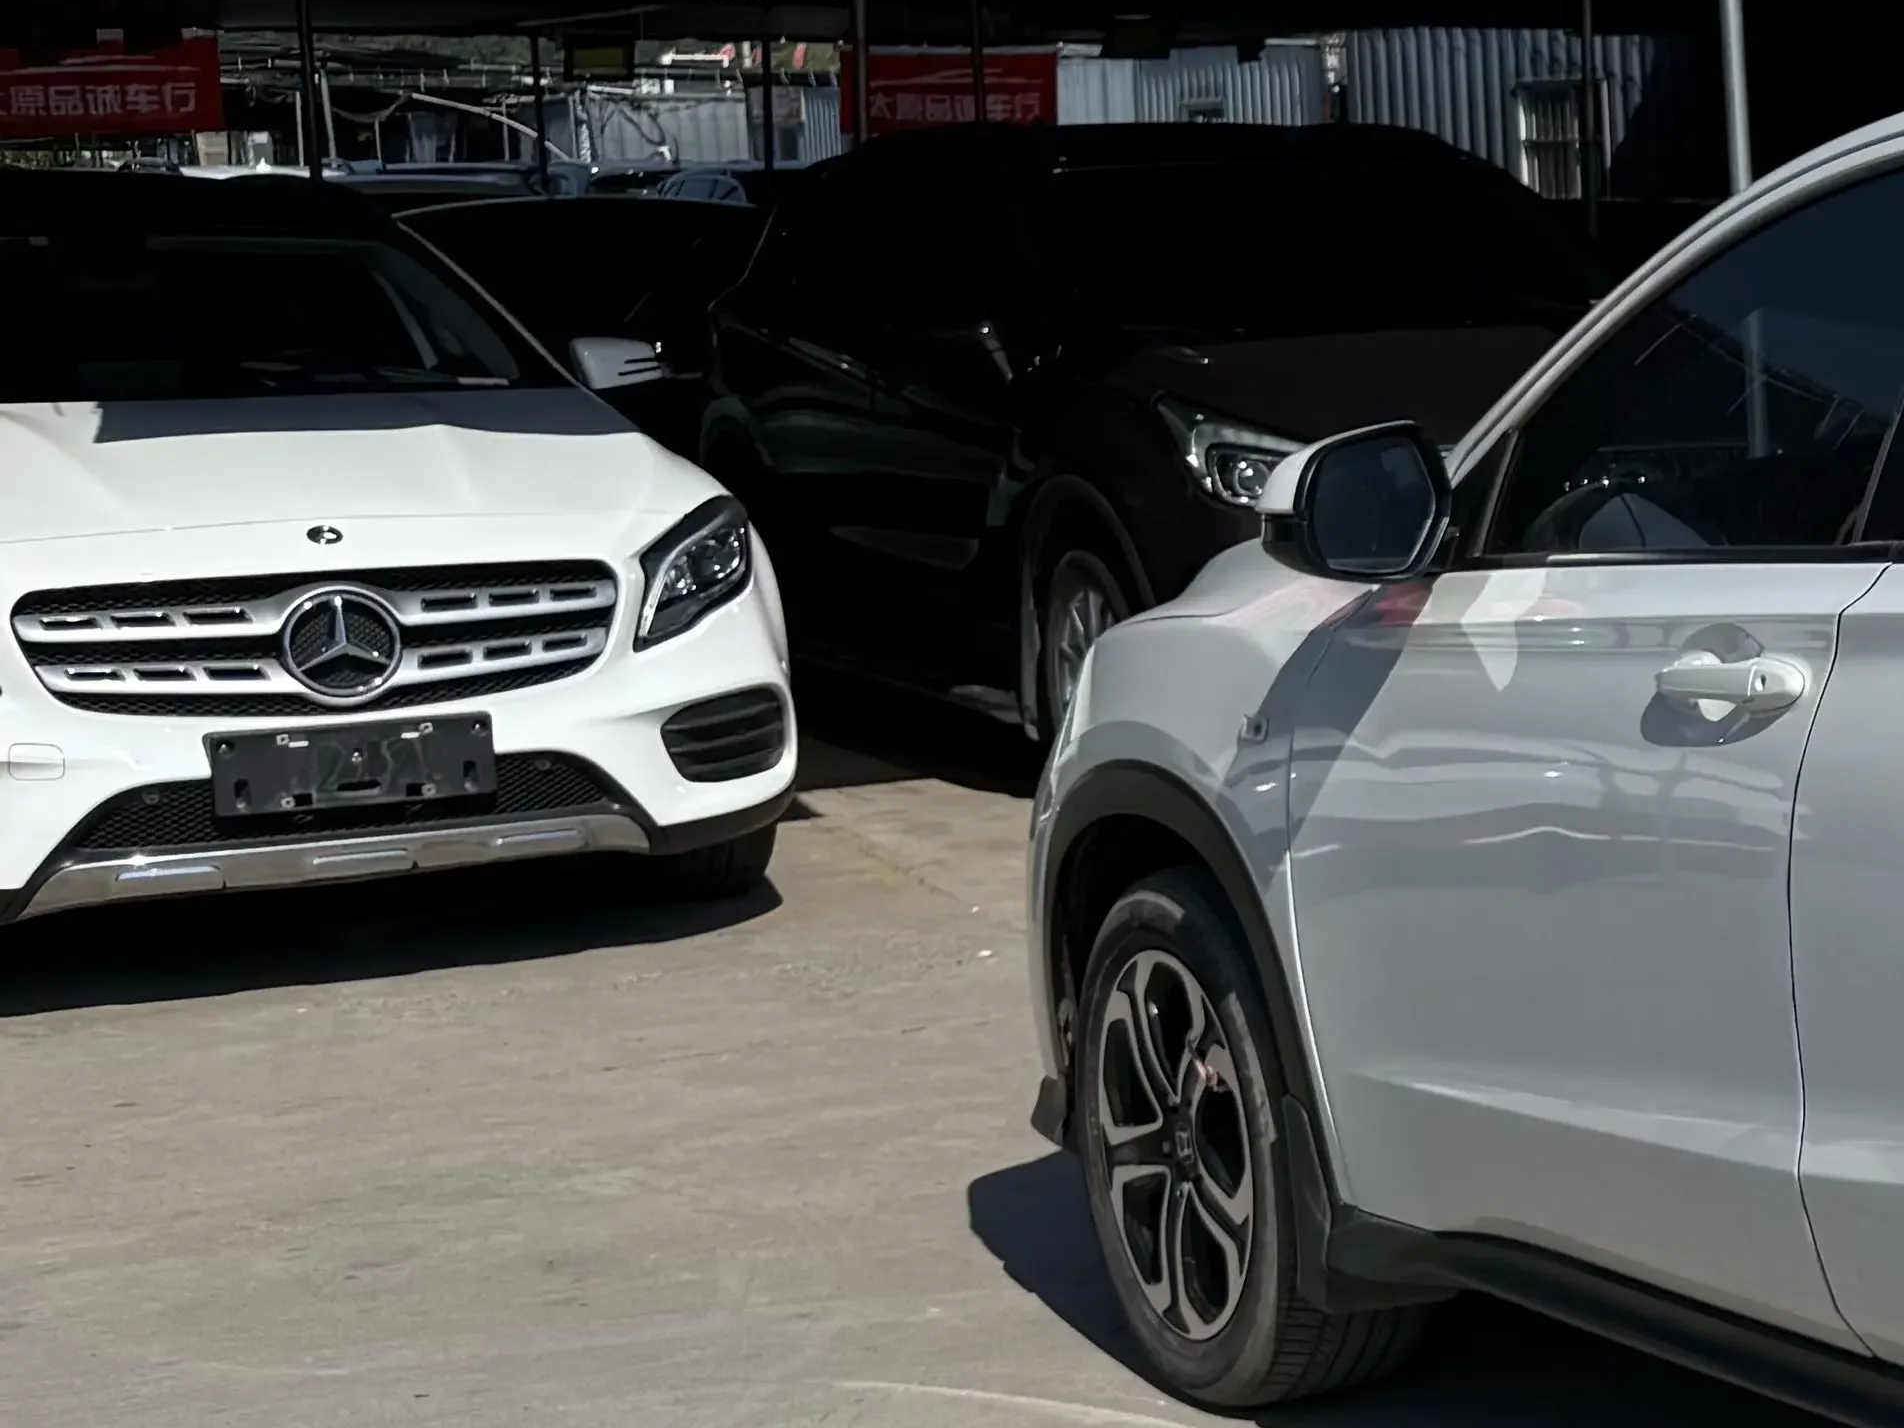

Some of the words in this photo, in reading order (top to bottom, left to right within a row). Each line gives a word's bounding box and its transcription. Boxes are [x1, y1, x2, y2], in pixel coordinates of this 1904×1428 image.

[0, 81, 197, 117] 原品诚车行
